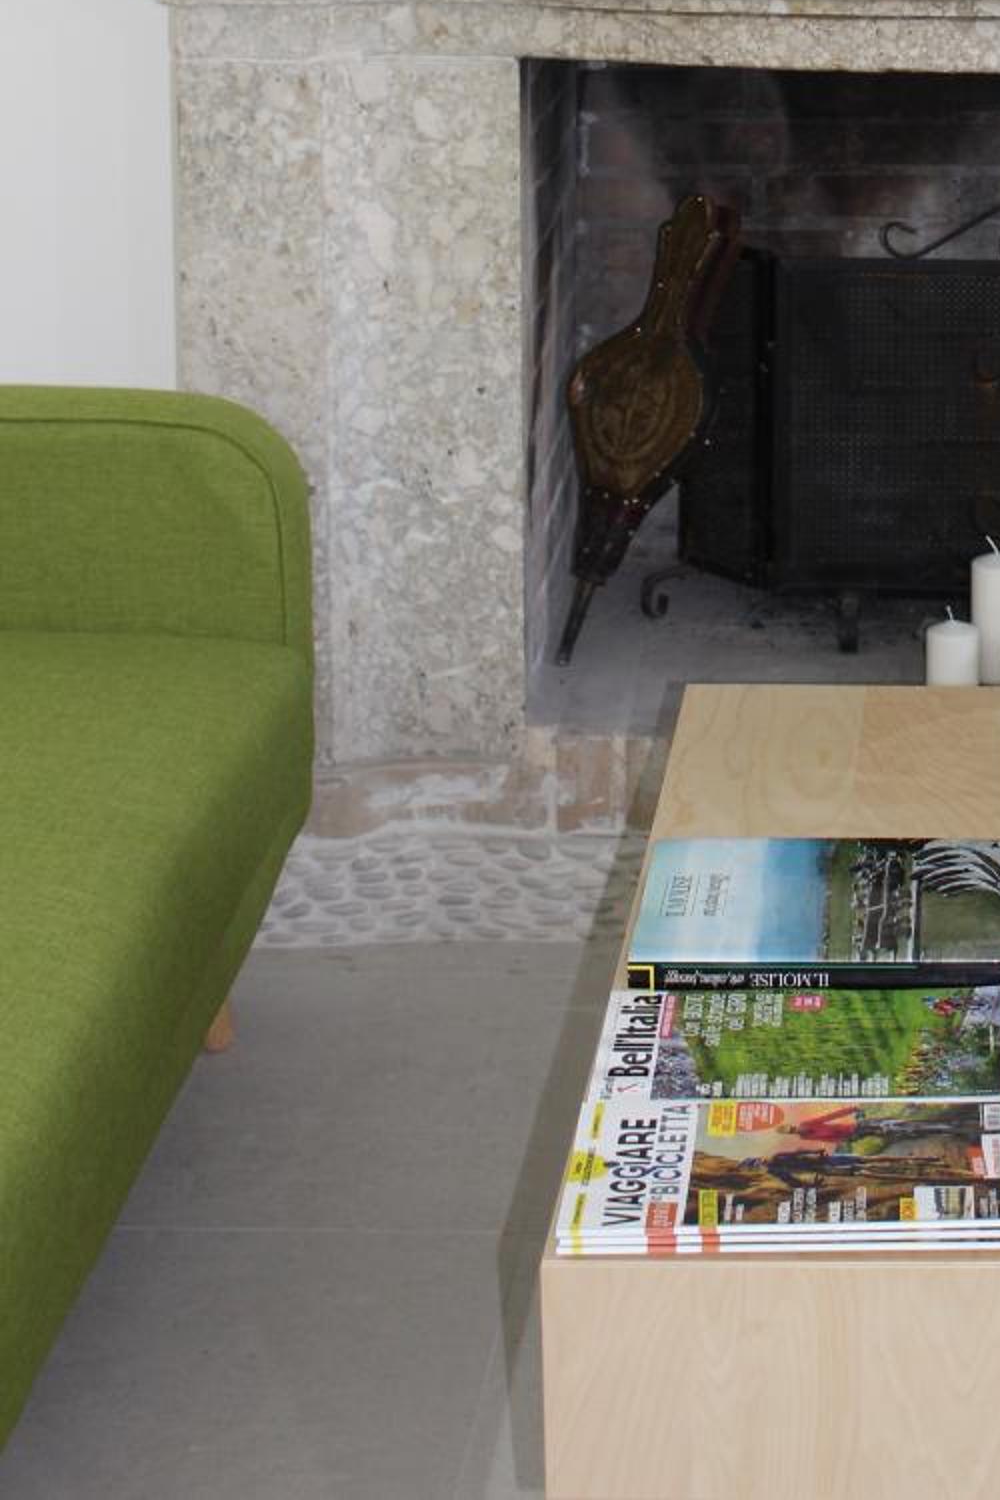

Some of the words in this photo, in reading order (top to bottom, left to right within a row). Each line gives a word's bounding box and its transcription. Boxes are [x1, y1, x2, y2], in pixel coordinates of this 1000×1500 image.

[750, 973, 809, 987] MOLISE
[608, 994, 662, 1078] Bell'Italia
[650, 1103, 691, 1196] BICICLETTA
